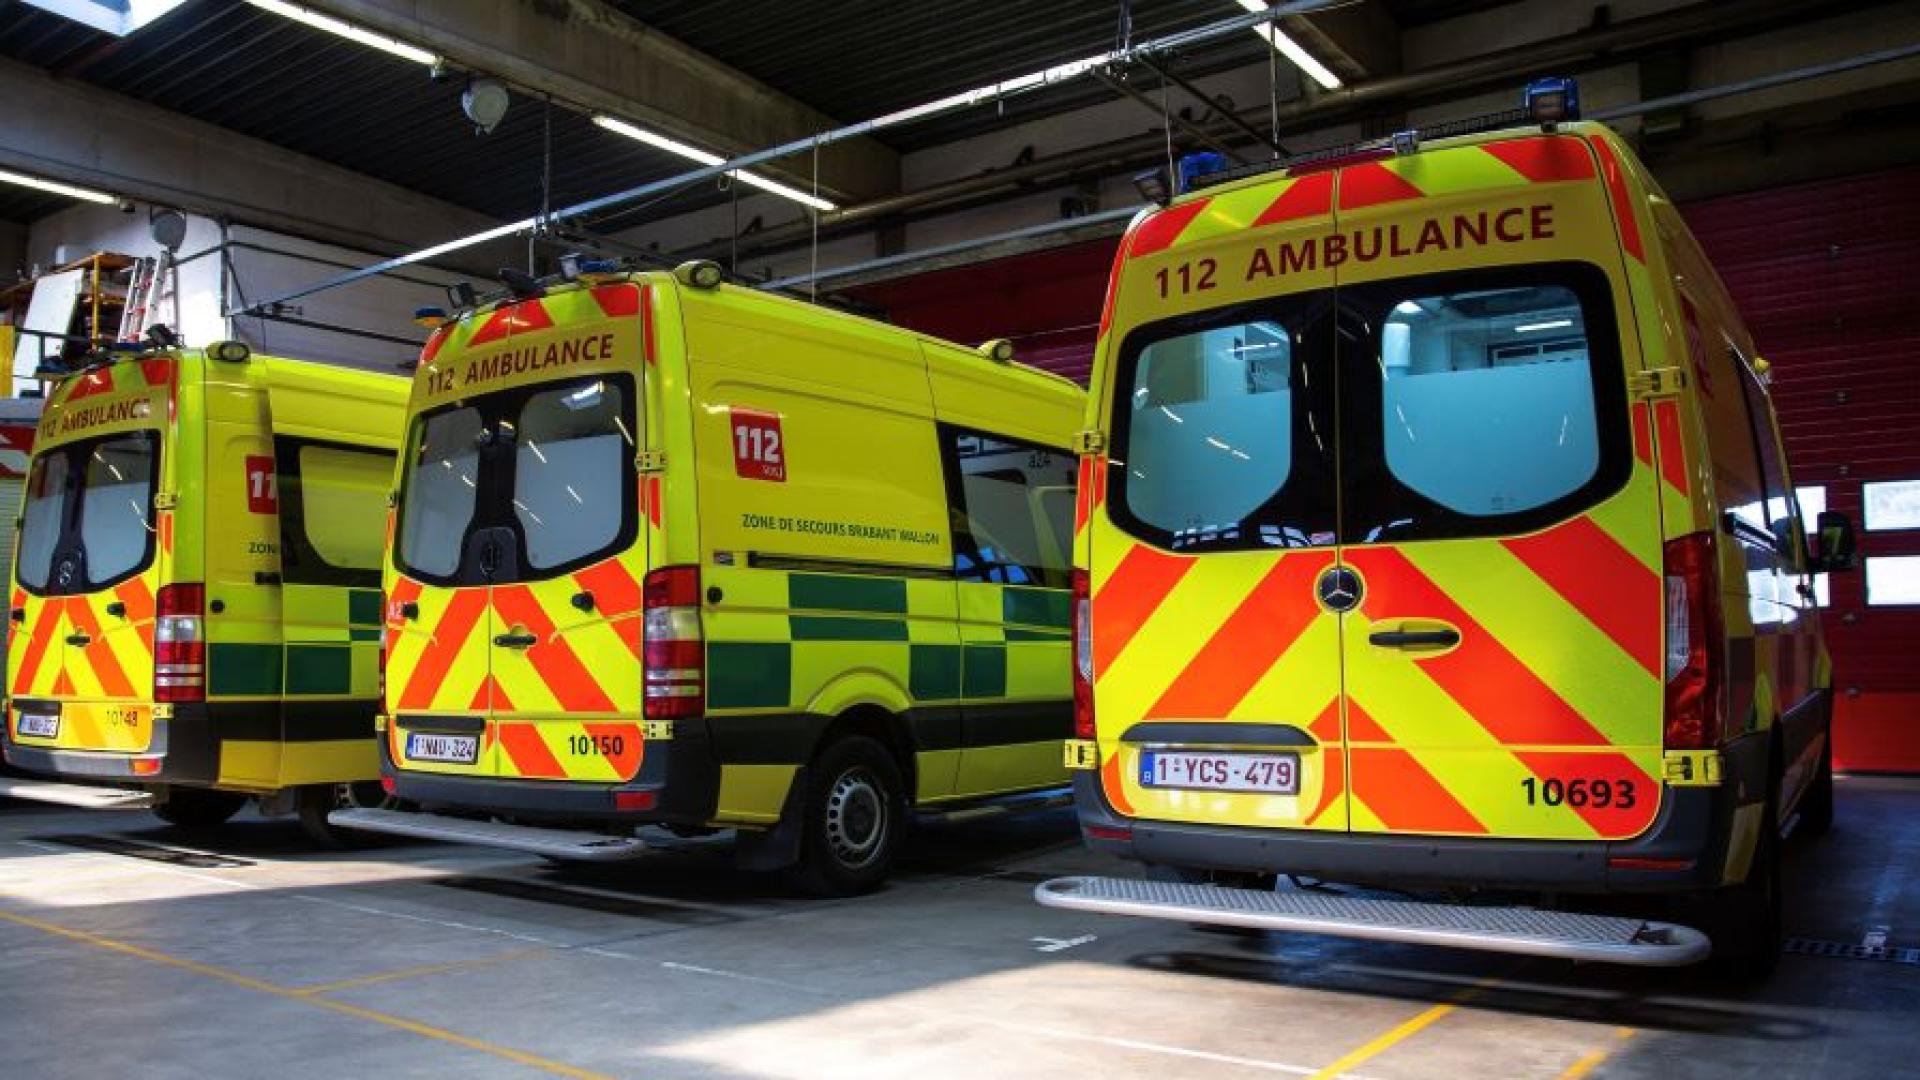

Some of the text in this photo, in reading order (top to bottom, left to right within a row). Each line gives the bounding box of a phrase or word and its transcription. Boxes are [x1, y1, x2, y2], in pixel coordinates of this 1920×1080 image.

[1155, 204, 1556, 300] 112 AMBULANCE
[427, 333, 614, 396] 112 AMBULANCE
[736, 425, 781, 464] 112
[742, 513, 776, 530] ZONE
[779, 518, 793, 532] DE
[796, 518, 847, 537] SECOURS
[849, 524, 898, 542] BRABANT
[568, 735, 624, 757] 10150
[1521, 775, 1637, 810] 10693
